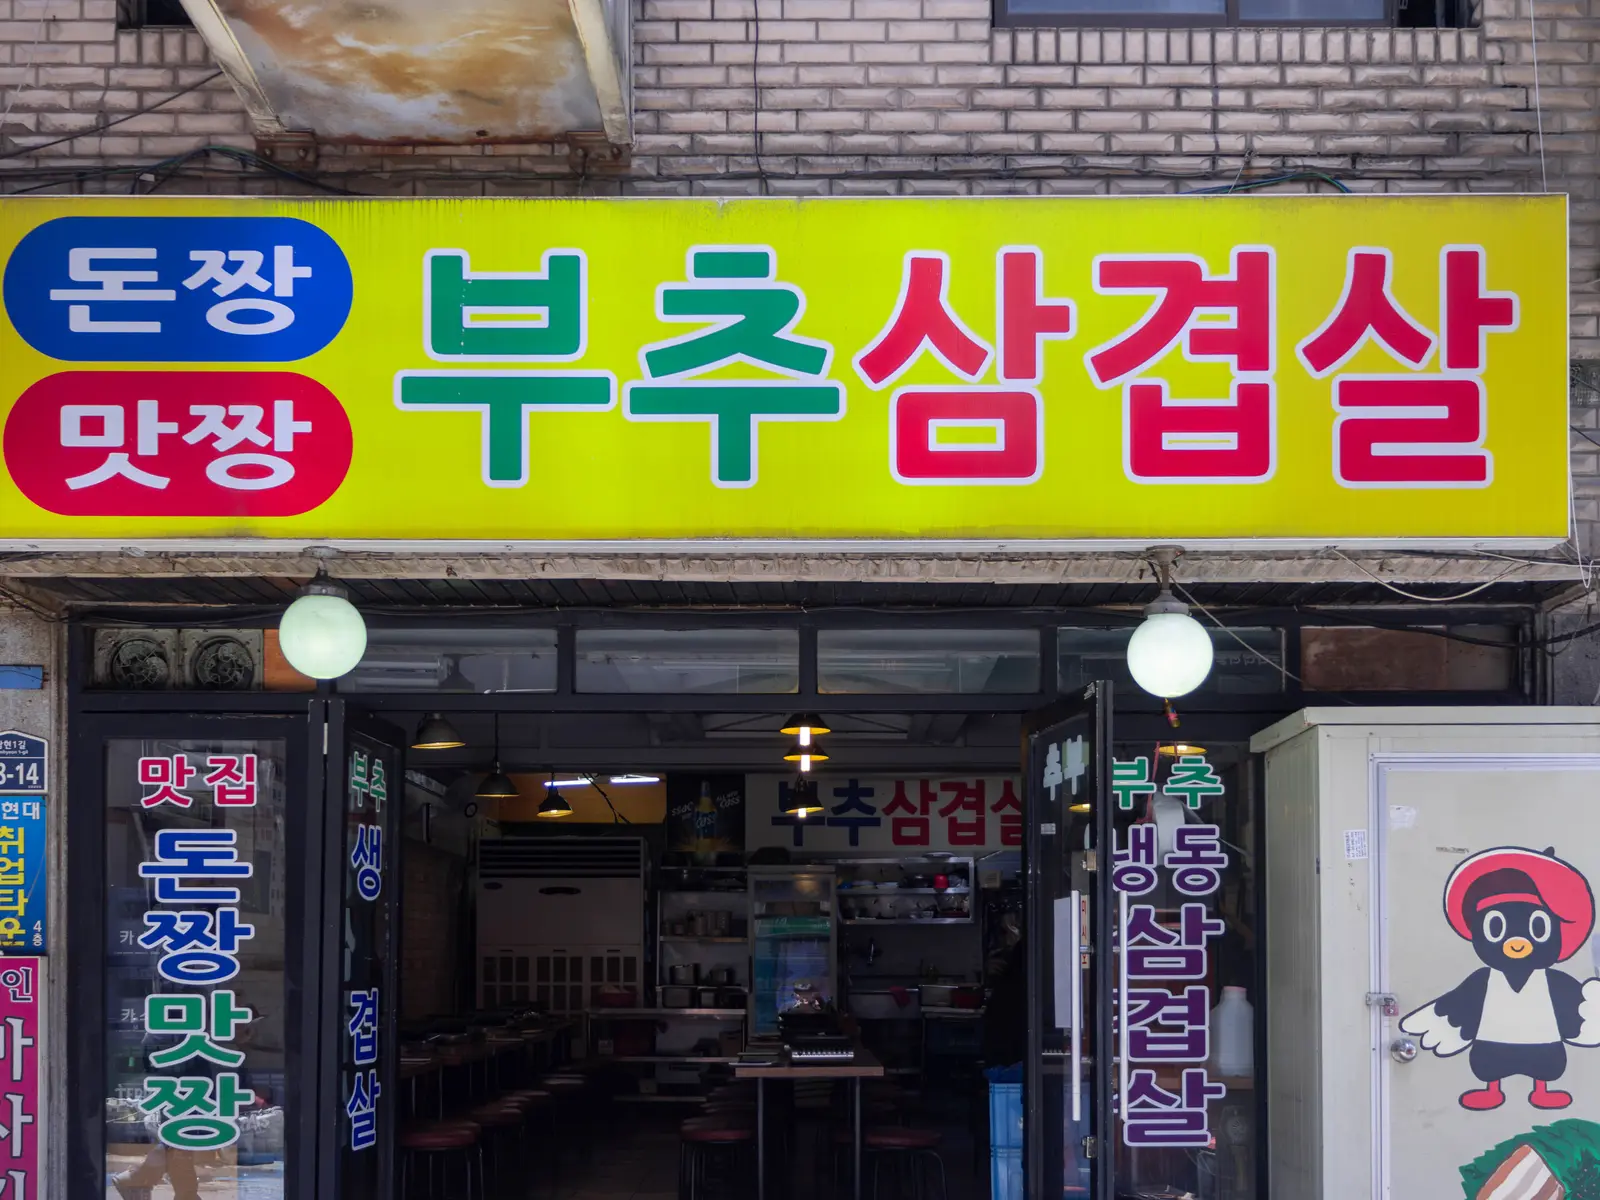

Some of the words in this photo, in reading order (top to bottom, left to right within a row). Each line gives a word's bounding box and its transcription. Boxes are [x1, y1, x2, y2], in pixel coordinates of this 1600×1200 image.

[49, 244, 312, 335] 돈짱
[59, 399, 312, 491] 맛짱
[1, 801, 41, 820] 현대
[138, 753, 258, 807] 맛집
[351, 750, 387, 813] 부추
[1112, 755, 1225, 810] 부추
[351, 822, 383, 901] 생
[1112, 822, 1229, 896] 냉동
[32, 919, 43, 947] 4층
[139, 828, 255, 984] 돈짱
[1112, 902, 1228, 1147] 삼겹살
[0, 1016, 35, 1200] 마사
[139, 989, 255, 1151] 맛짱
